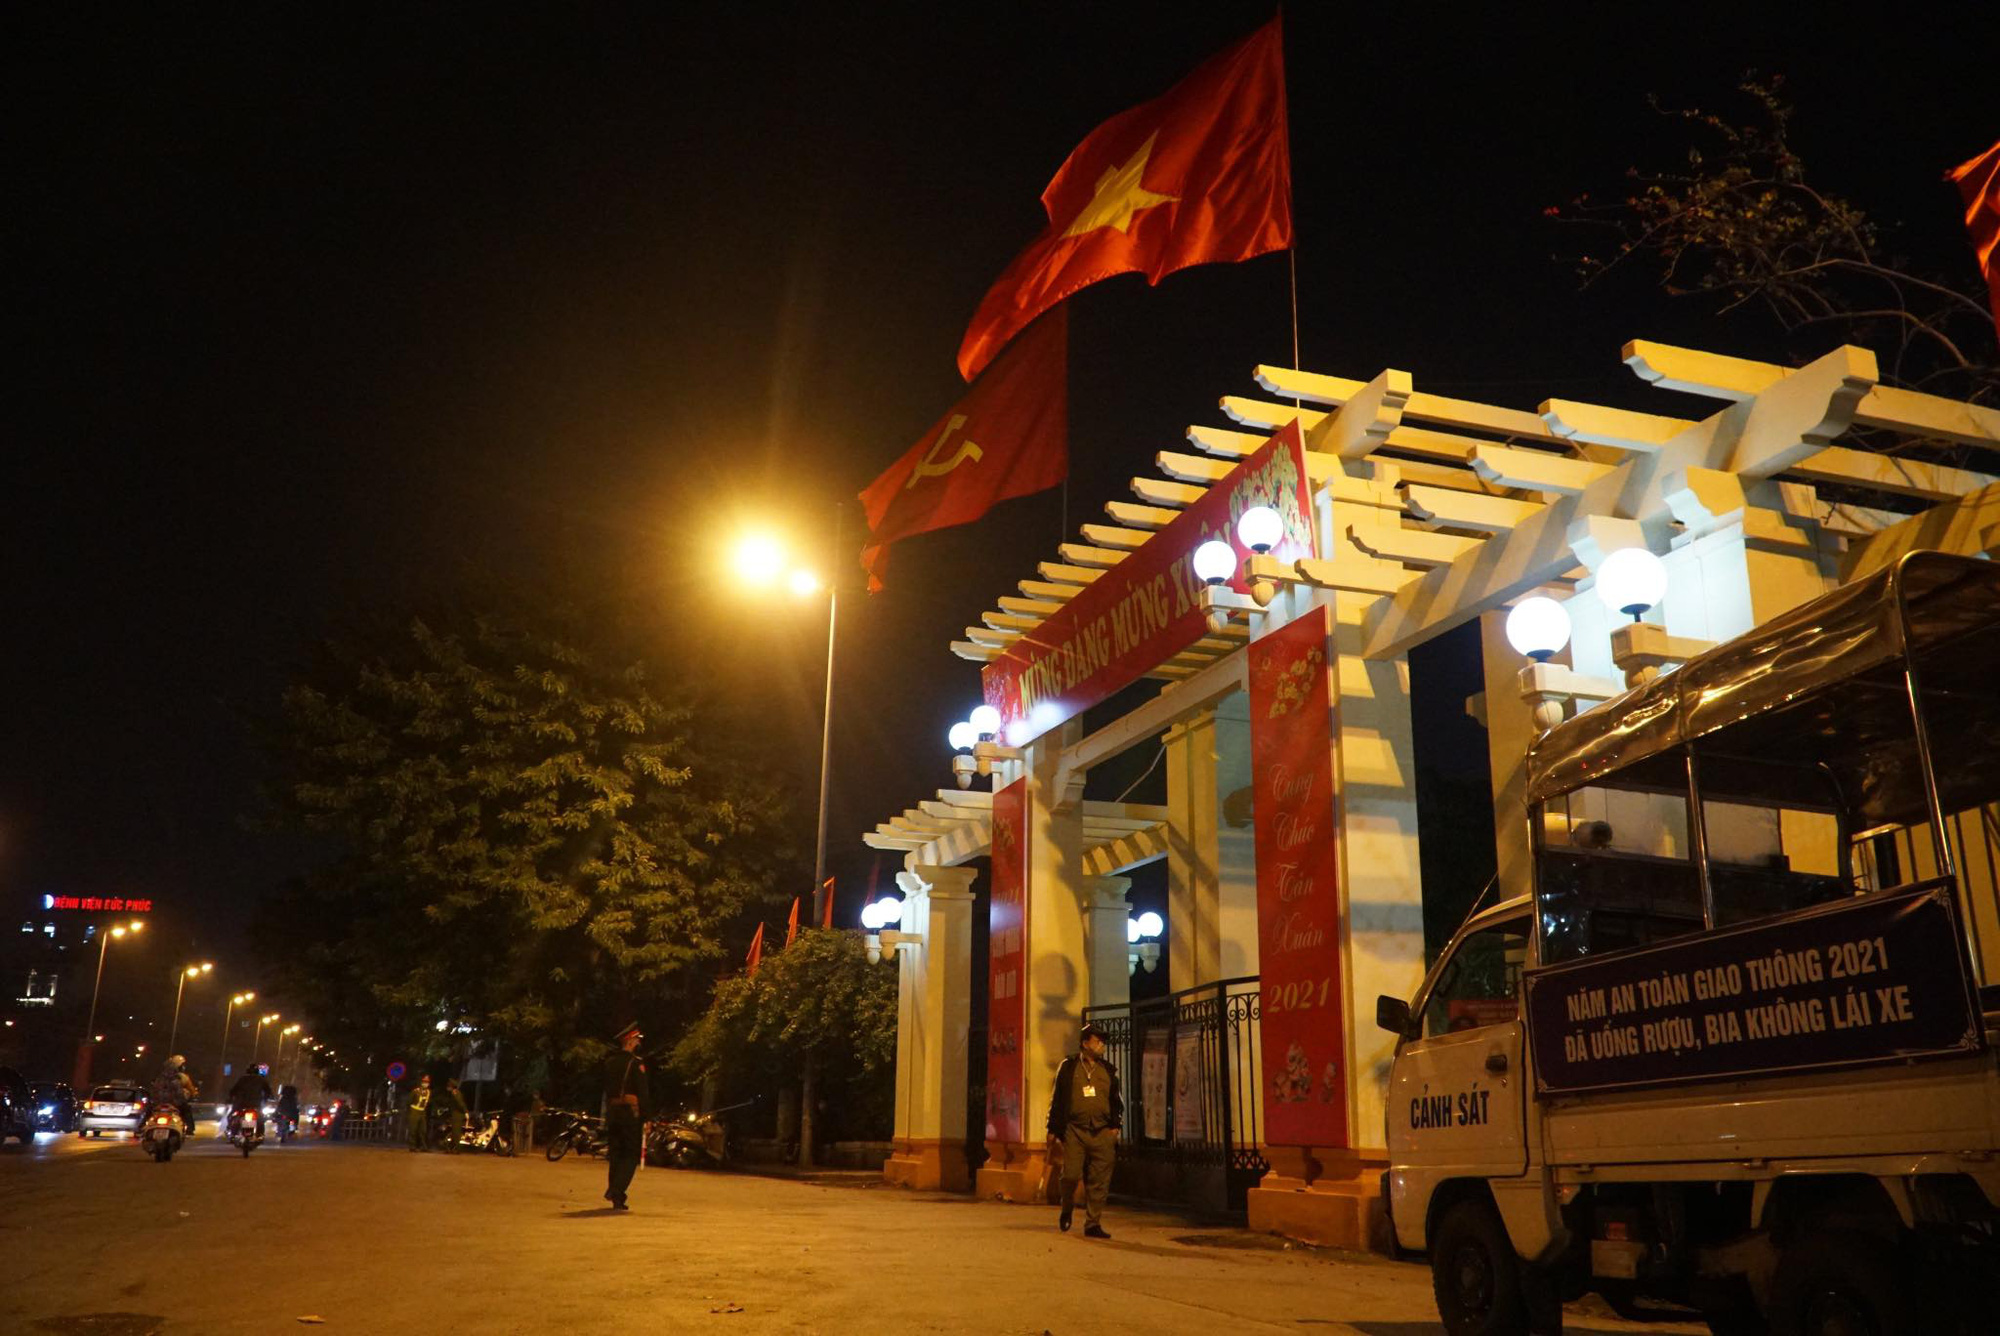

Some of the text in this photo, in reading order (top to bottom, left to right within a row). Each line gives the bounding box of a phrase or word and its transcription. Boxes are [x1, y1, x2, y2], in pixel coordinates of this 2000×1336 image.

[1268, 763, 1313, 807] Cung
[1273, 812, 1314, 851] Chúc
[1274, 862, 1313, 902] Tân
[1272, 912, 1323, 955] Xuân
[1267, 977, 1330, 1012] 2021
[1567, 937, 1888, 1022] NĂM AN TOÀN GIAO THÔNG 2021
[1565, 1029, 1588, 1063] ĐÃ
[1591, 1020, 1640, 1060] UỐNG
[1704, 1011, 1742, 1045] BIA
[1746, 997, 1826, 1040] KHÔNG
[1830, 986, 1872, 1029] LÁI
[1876, 985, 1913, 1023] XE
[1411, 1082, 1490, 1129] CẢNH SÁT
